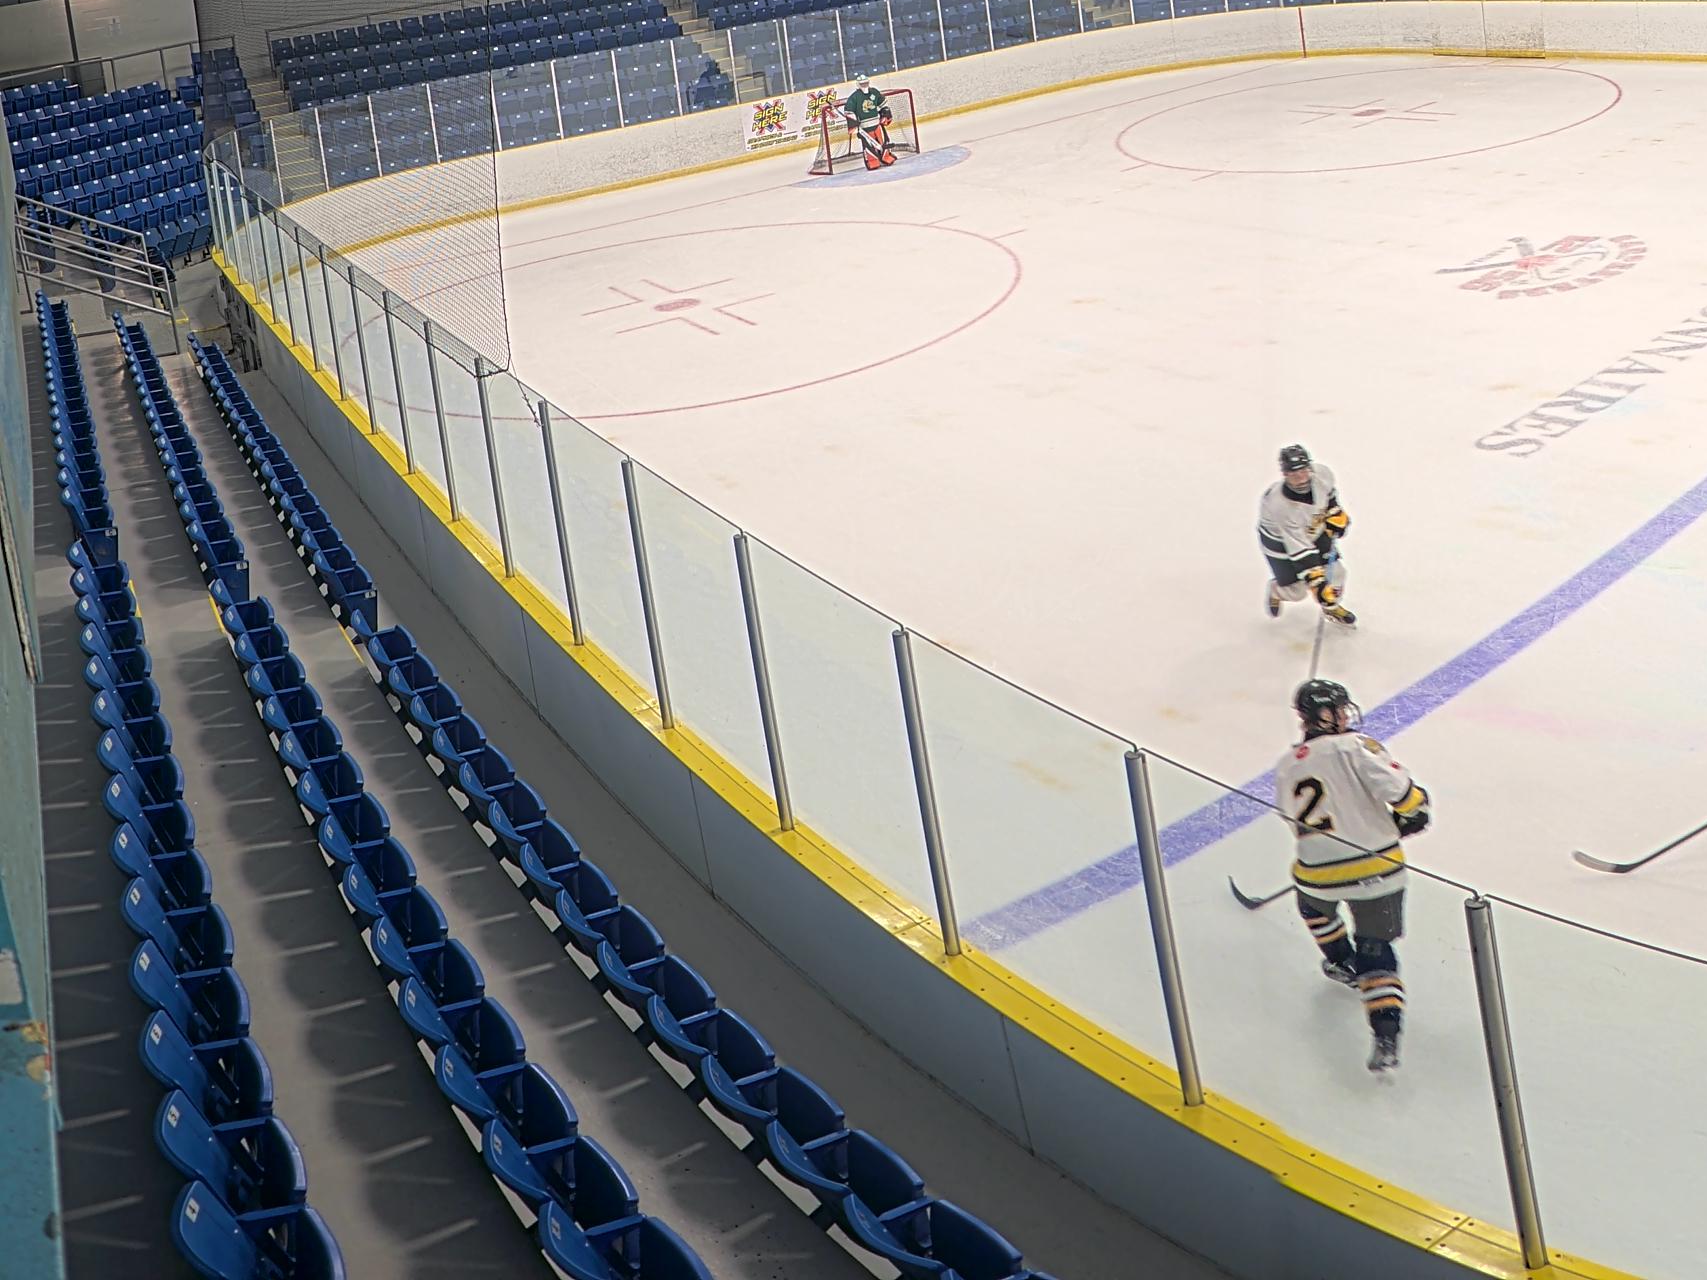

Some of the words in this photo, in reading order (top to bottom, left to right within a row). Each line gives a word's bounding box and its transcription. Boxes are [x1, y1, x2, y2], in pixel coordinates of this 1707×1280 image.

[807, 92, 837, 109] SIGN
[752, 111, 787, 132] HERE
[754, 103, 784, 121] SIGN
[1293, 777, 1335, 836] 2
